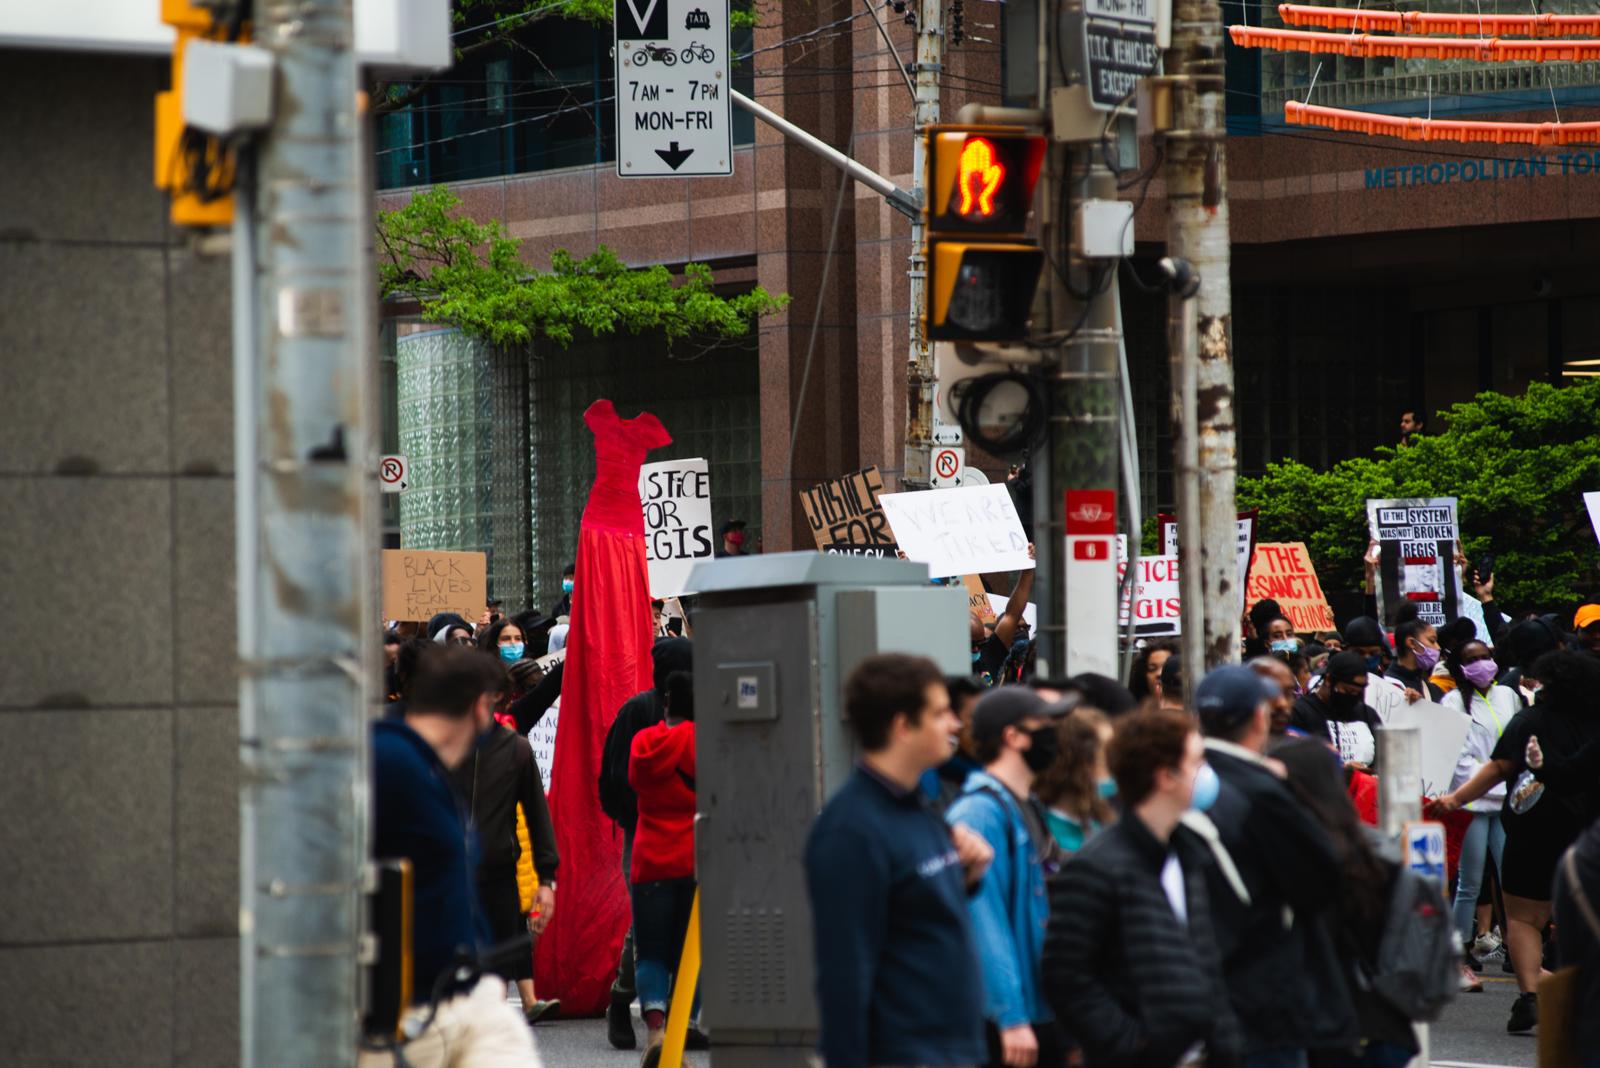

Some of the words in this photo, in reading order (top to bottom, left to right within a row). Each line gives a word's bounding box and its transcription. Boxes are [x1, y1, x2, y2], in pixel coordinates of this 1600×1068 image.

[689, 14, 707, 24] TAXI
[1113, 38, 1158, 68] VEHICLES
[635, 110, 713, 131] MON-FRI
[1364, 155, 1547, 190] METROPOLITAN
[1382, 511, 1390, 521] IF
[1391, 511, 1404, 521] THE
[1409, 509, 1447, 524] SYSTEM
[1380, 528, 1397, 539] WAS
[1398, 528, 1411, 538] NOT
[1414, 525, 1453, 540] BROKEN
[1403, 542, 1436, 558] REGIS
[403, 556, 465, 579] BLACK
[1258, 547, 1307, 574] THE
[411, 578, 473, 594] LIVES
